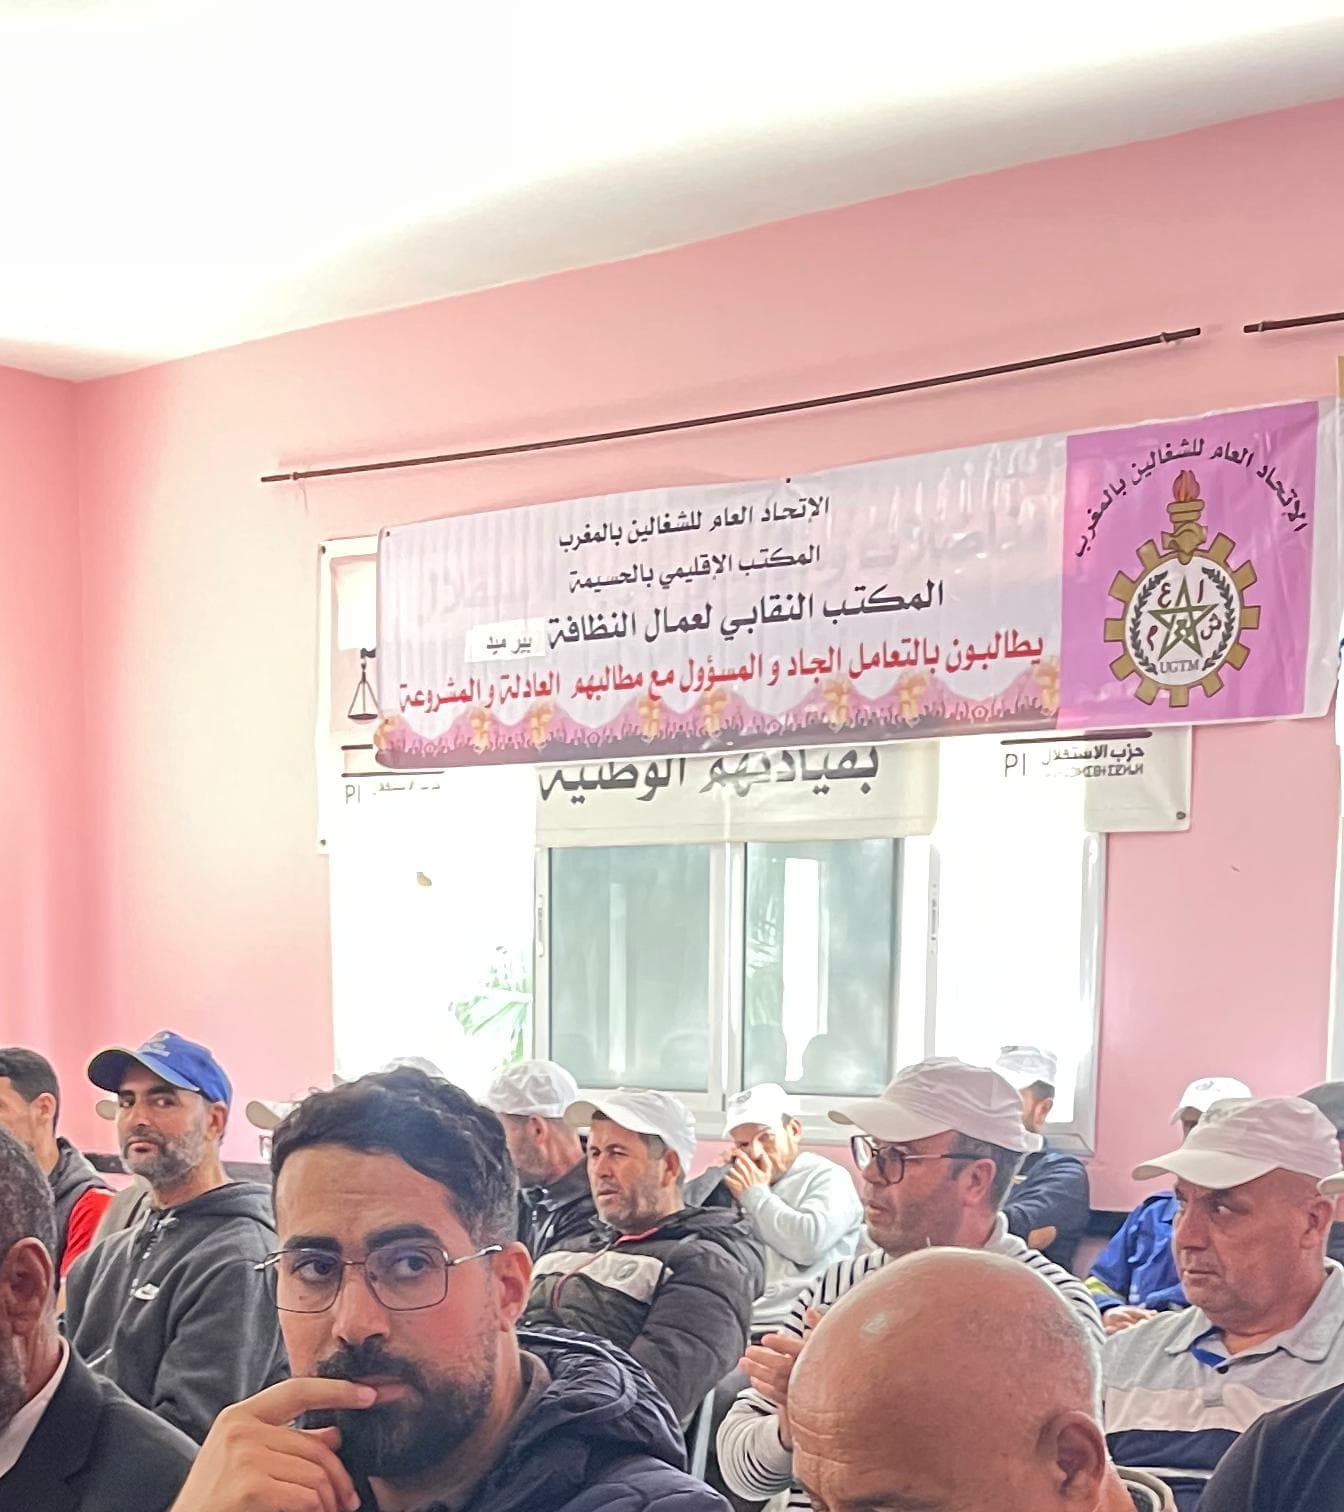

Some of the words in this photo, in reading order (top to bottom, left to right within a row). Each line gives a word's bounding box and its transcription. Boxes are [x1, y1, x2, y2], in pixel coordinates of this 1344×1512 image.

[1129, 437, 1205, 486] للشغالين
[1209, 441, 1256, 469] العام
[627, 509, 703, 544] للشغالين
[709, 505, 753, 532] العام
[1074, 476, 1128, 558] بالمغرب
[558, 521, 623, 553] بالمغرب
[738, 544, 821, 576] المكتب
[568, 563, 654, 594] بالحسيمة
[720, 592, 814, 641] النقابي
[822, 578, 944, 625] المكتب
[547, 610, 636, 650] النظافة
[643, 601, 712, 643] لعمال
[786, 646, 842, 685] الجاد
[848, 635, 941, 681] بالتعامل
[944, 628, 1044, 674] يطالبون
[1159, 658, 1200, 674] UGTM
[499, 670, 561, 704] العادلة
[570, 662, 644, 702] مطالبهم
[648, 666, 674, 700] مع
[679, 652, 763, 694] المسؤول
[767, 659, 781, 687] و
[398, 676, 482, 714] المشروعة
[484, 684, 495, 709] و
[1004, 752, 1026, 778] PI
[1109, 743, 1145, 763] حزب
